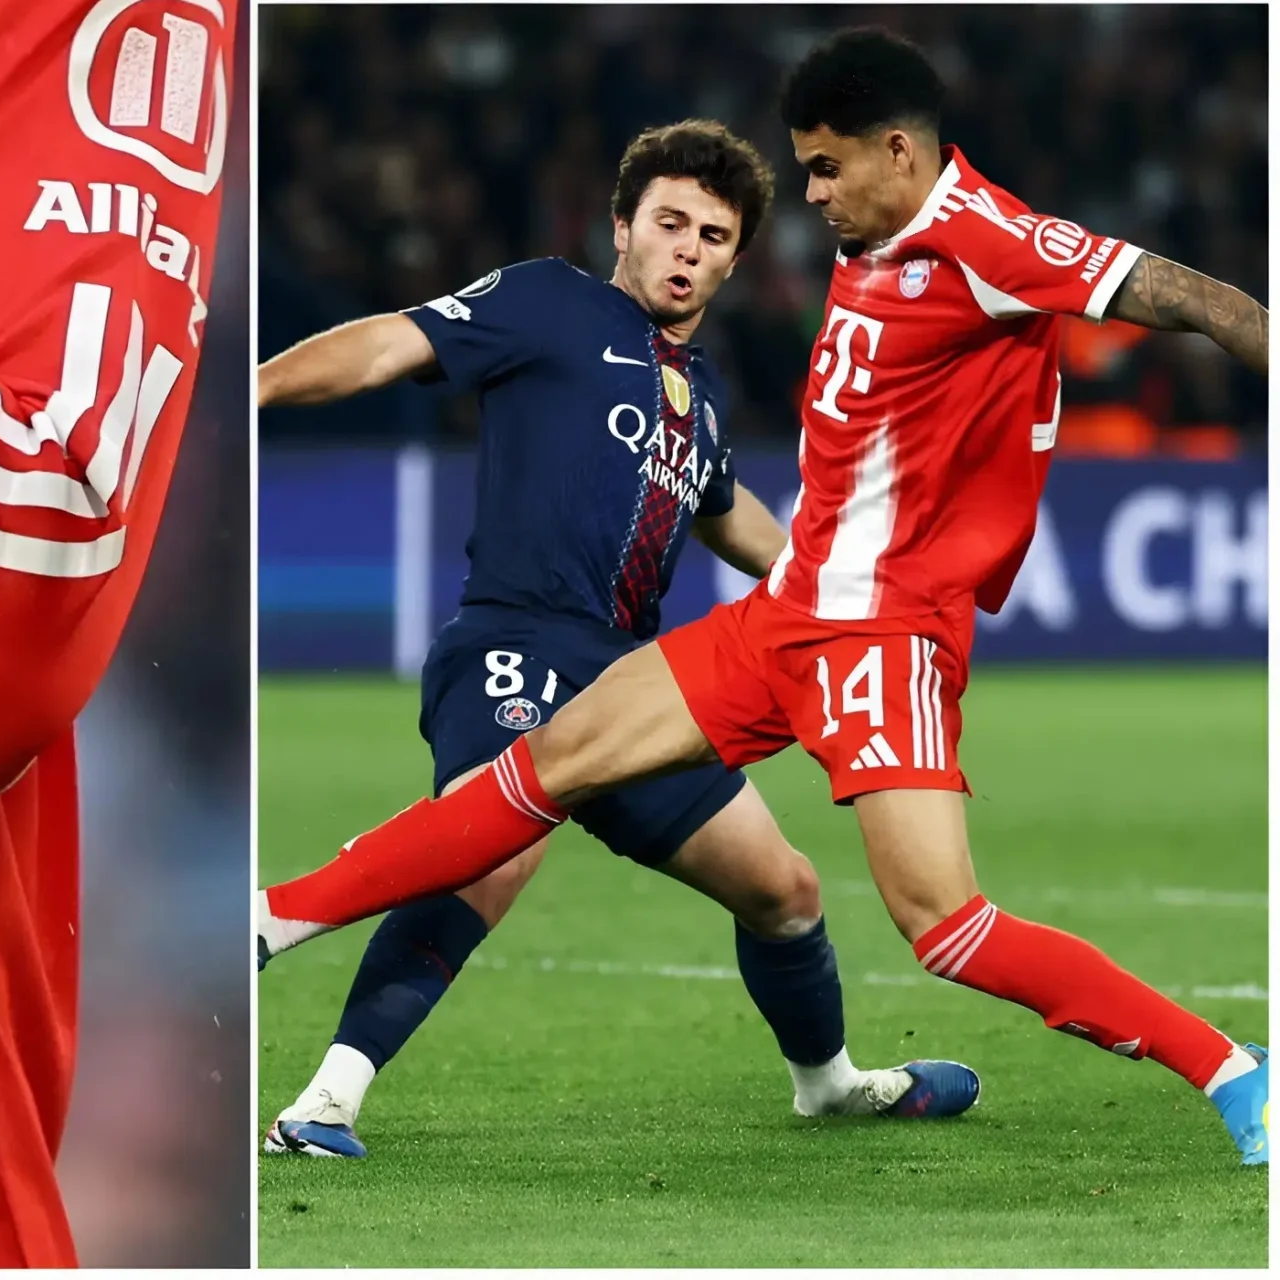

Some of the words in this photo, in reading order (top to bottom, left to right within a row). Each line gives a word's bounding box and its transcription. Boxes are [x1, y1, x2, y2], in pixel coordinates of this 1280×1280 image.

[814, 304, 884, 424] T
[485, 650, 557, 704] 81
[816, 645, 884, 739] 14
